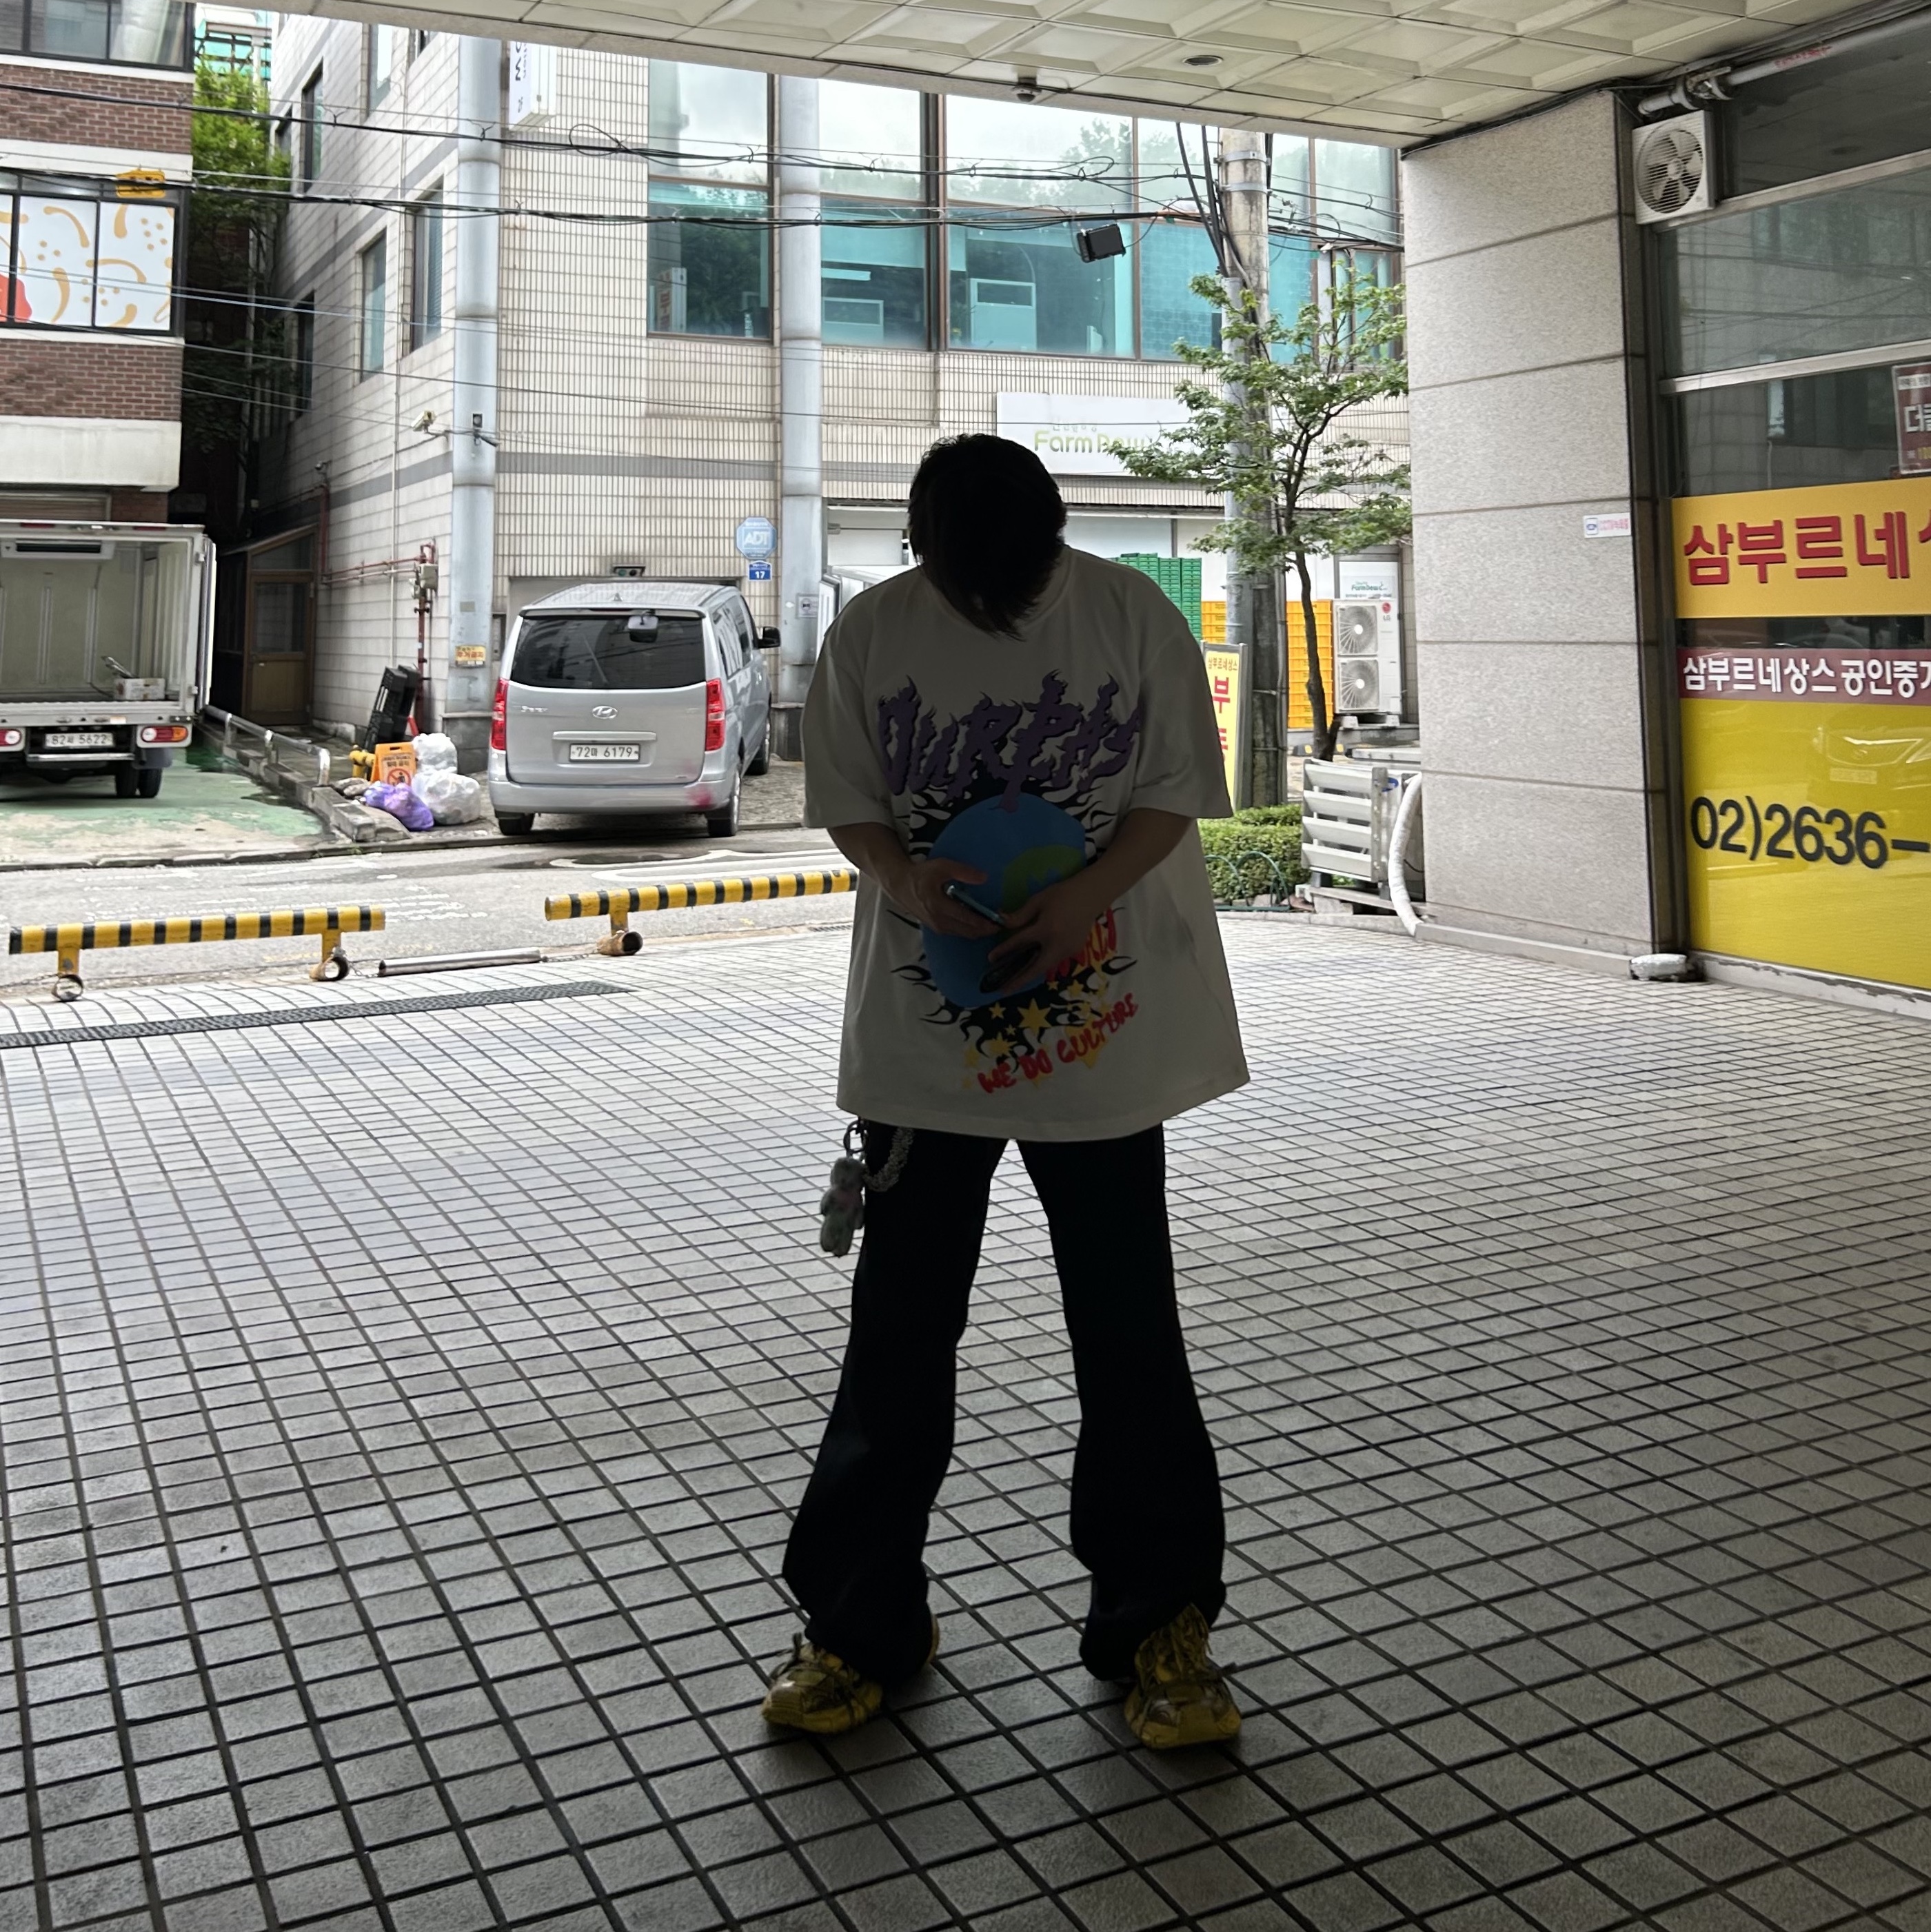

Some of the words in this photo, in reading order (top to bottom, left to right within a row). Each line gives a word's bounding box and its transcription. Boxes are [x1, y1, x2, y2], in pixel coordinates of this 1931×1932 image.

[744, 530, 770, 546] ADT
[1684, 511, 1931, 586] 삼부르네
[755, 571, 765, 579] 17
[1208, 657, 1238, 671] 삼부르네상스
[1684, 657, 1837, 695] 삼부르네상스
[79, 734, 108, 744] 5622
[576, 746, 598, 758] 72마
[604, 746, 632, 758] 6179
[978, 1061, 1017, 1093] WE
[1018, 1048, 1053, 1079] DO
[1056, 992, 1138, 1063] CULTURE
